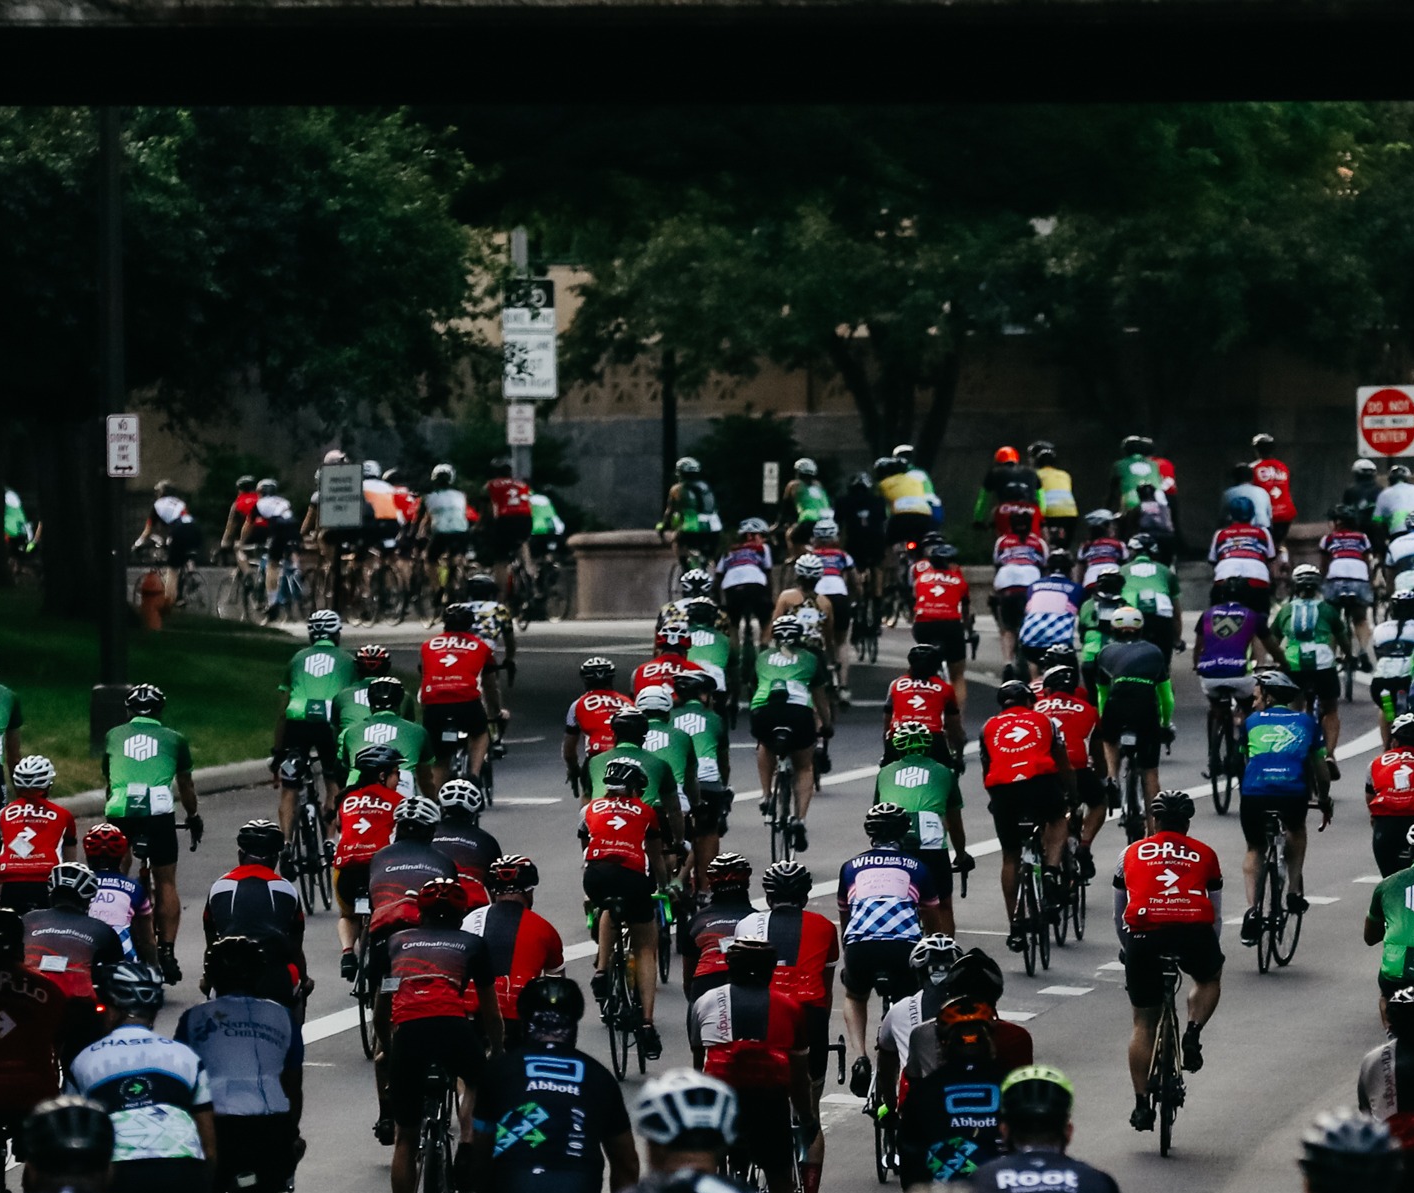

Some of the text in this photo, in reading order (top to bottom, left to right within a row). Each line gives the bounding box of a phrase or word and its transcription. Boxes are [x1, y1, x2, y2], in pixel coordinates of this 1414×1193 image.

[1367, 399, 1409, 414] DO NOT
[1371, 429, 1407, 443] ENTER
[429, 636, 479, 650] Ohio
[896, 678, 942, 692] Ohio
[1033, 698, 1084, 713] Ohio
[343, 796, 392, 813] Ohio
[592, 799, 642, 815] Ohio
[5, 804, 57, 821] Ohio
[432, 836, 478, 848] ardinalHealth
[1138, 842, 1200, 862] Ohio
[852, 856, 884, 868] WHO
[902, 857, 918, 867] YOU
[31, 927, 94, 943] CardinalHealth
[402, 941, 466, 951] CardinalHealth
[90, 1038, 153, 1052] CHASE
[526, 1080, 580, 1096] Abbott
[950, 1116, 997, 1128] Abbott
[996, 1168, 1079, 1189] Root
